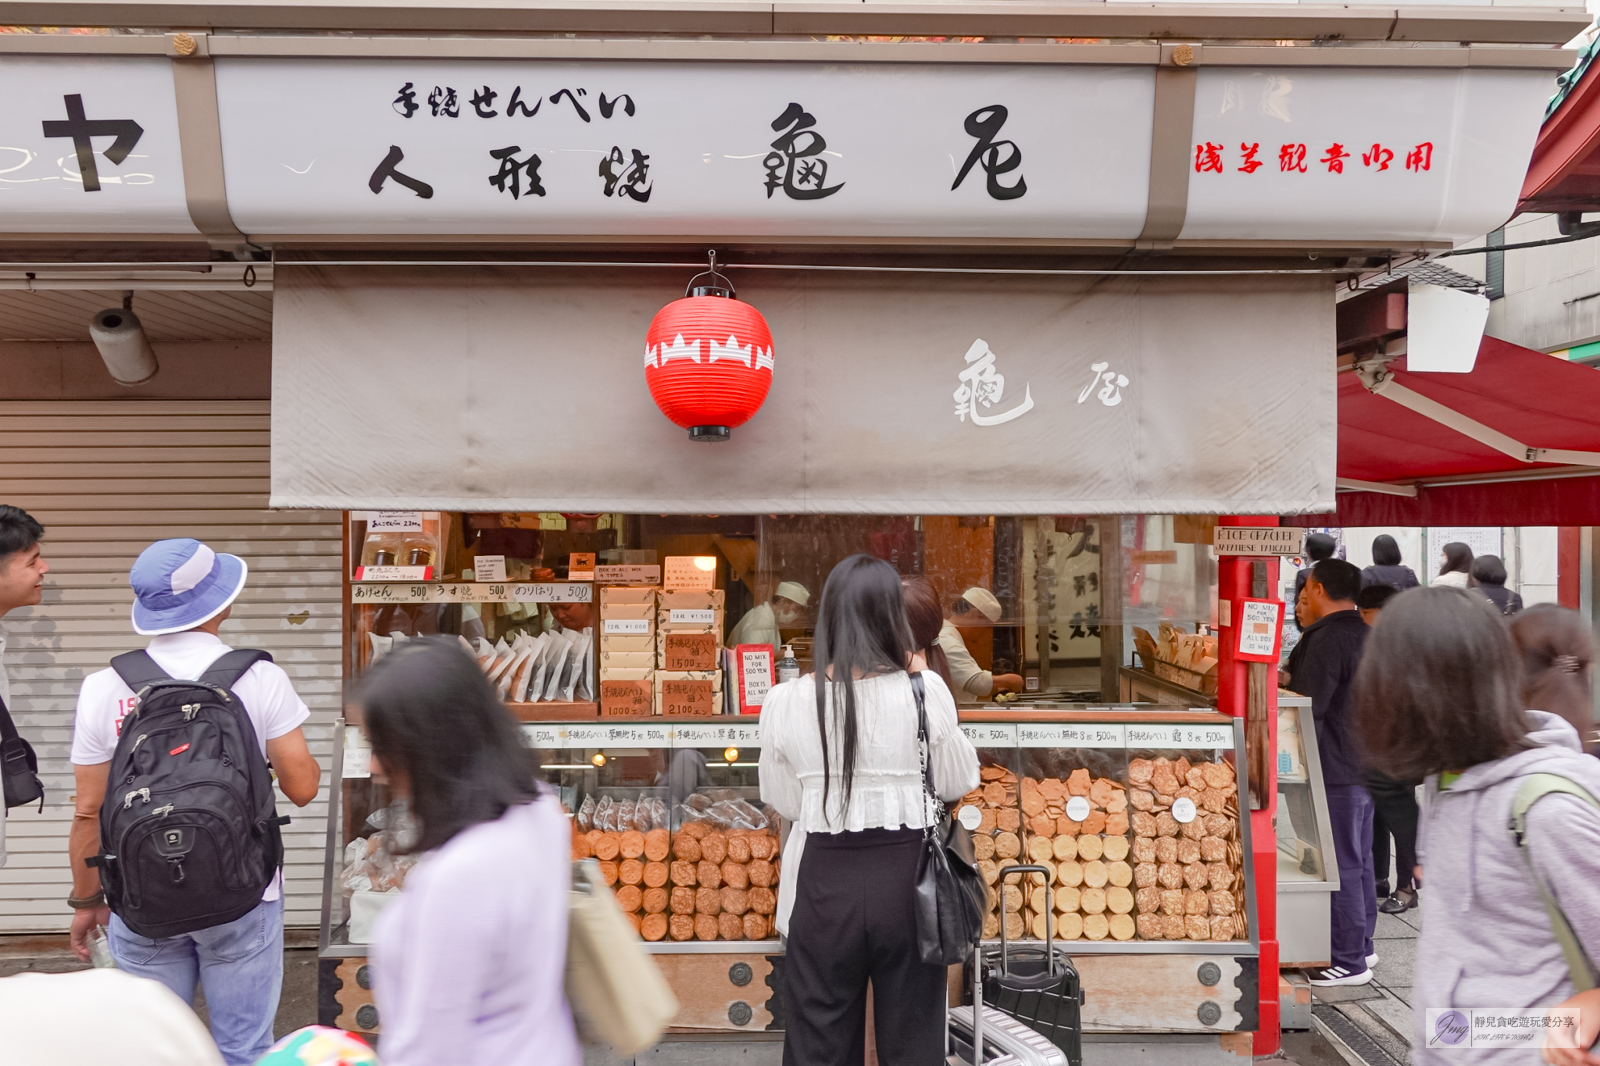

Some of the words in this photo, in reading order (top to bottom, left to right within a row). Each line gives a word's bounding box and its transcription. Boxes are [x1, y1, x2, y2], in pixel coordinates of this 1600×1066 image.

[391, 82, 636, 123] 手焼せんべい
[42, 93, 144, 192] ヤ
[369, 145, 653, 203] 人形焼
[1217, 530, 1247, 540] RICE
[1249, 530, 1294, 541] CRACKER
[1215, 543, 1257, 552] JAPANESE
[1260, 544, 1293, 552] PANCAKE
[354, 585, 392, 598] あげせん
[411, 586, 427, 597] 500
[489, 585, 505, 595] 500
[568, 586, 588, 597] 500
[1262, 604, 1275, 612] MIX
[1246, 614, 1259, 622] 500
[1262, 615, 1274, 623] YEN
[647, 730, 665, 741] 500円
[990, 730, 1009, 741] 500円
[1020, 730, 1061, 741] 手焼せんべい
[1096, 731, 1117, 742] 500円
[1128, 730, 1167, 741] 手焼せんべい
[1206, 731, 1226, 743] 500円
